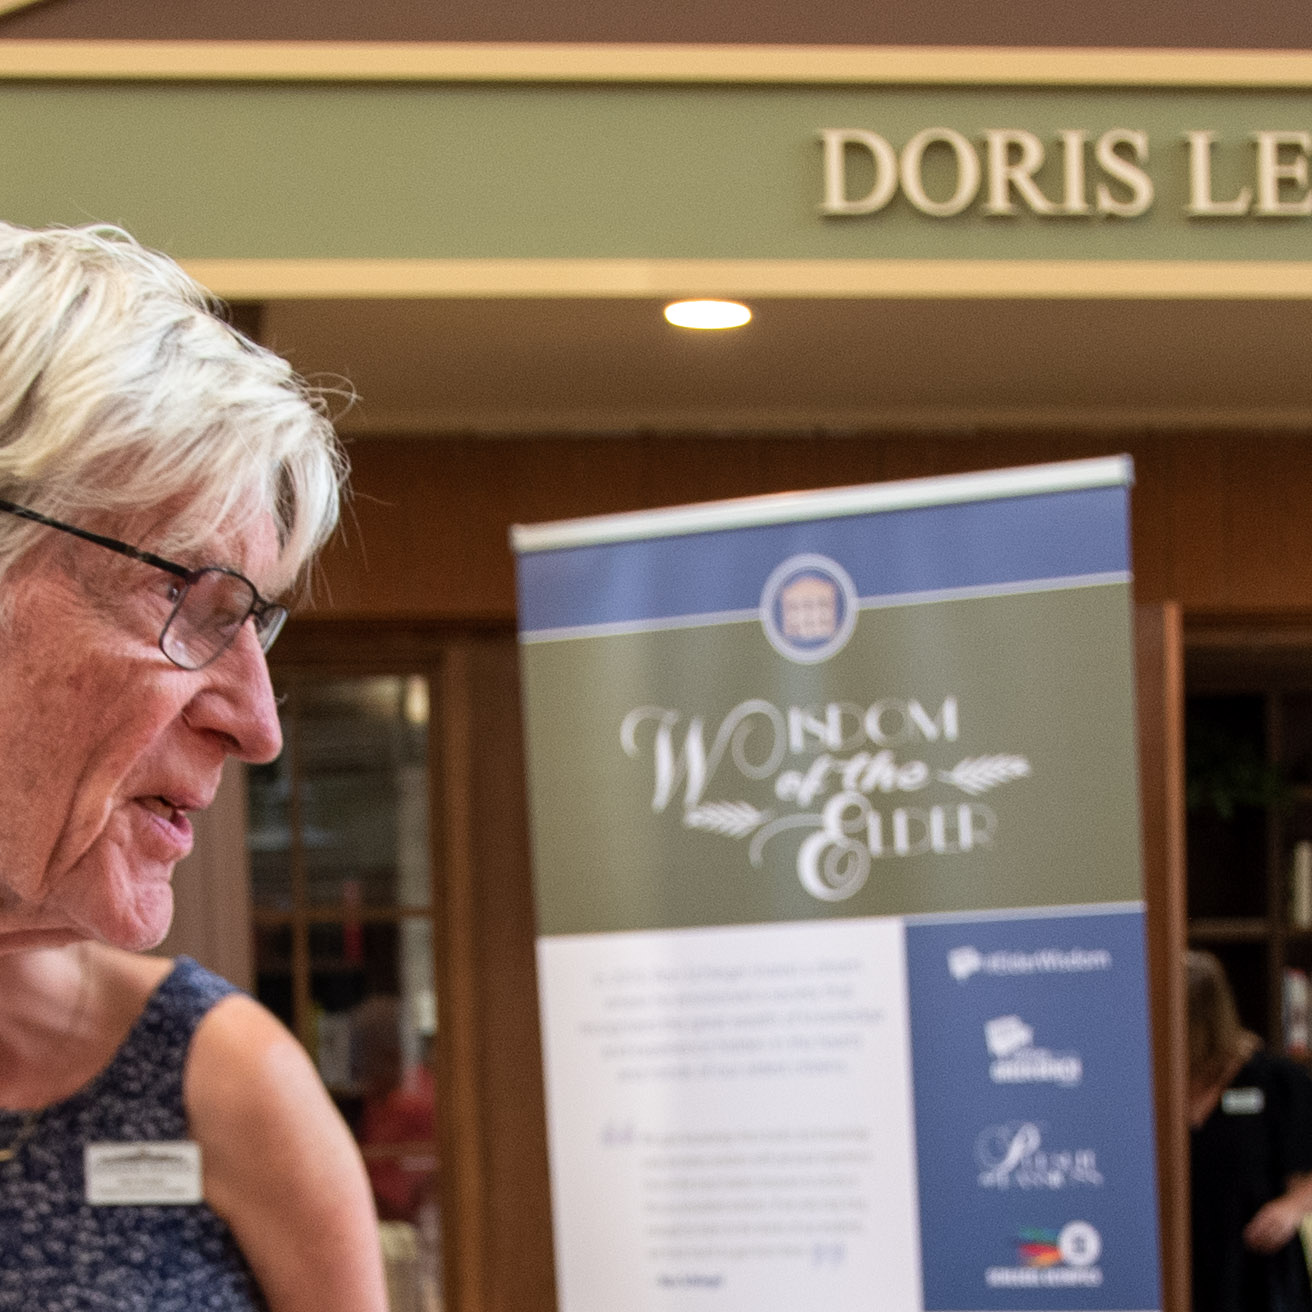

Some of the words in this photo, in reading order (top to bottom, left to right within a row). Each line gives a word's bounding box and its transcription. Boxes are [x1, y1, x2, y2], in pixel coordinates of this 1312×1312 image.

[819, 127, 1155, 217] DORIS
[775, 752, 835, 808] of
[835, 750, 929, 795] the
